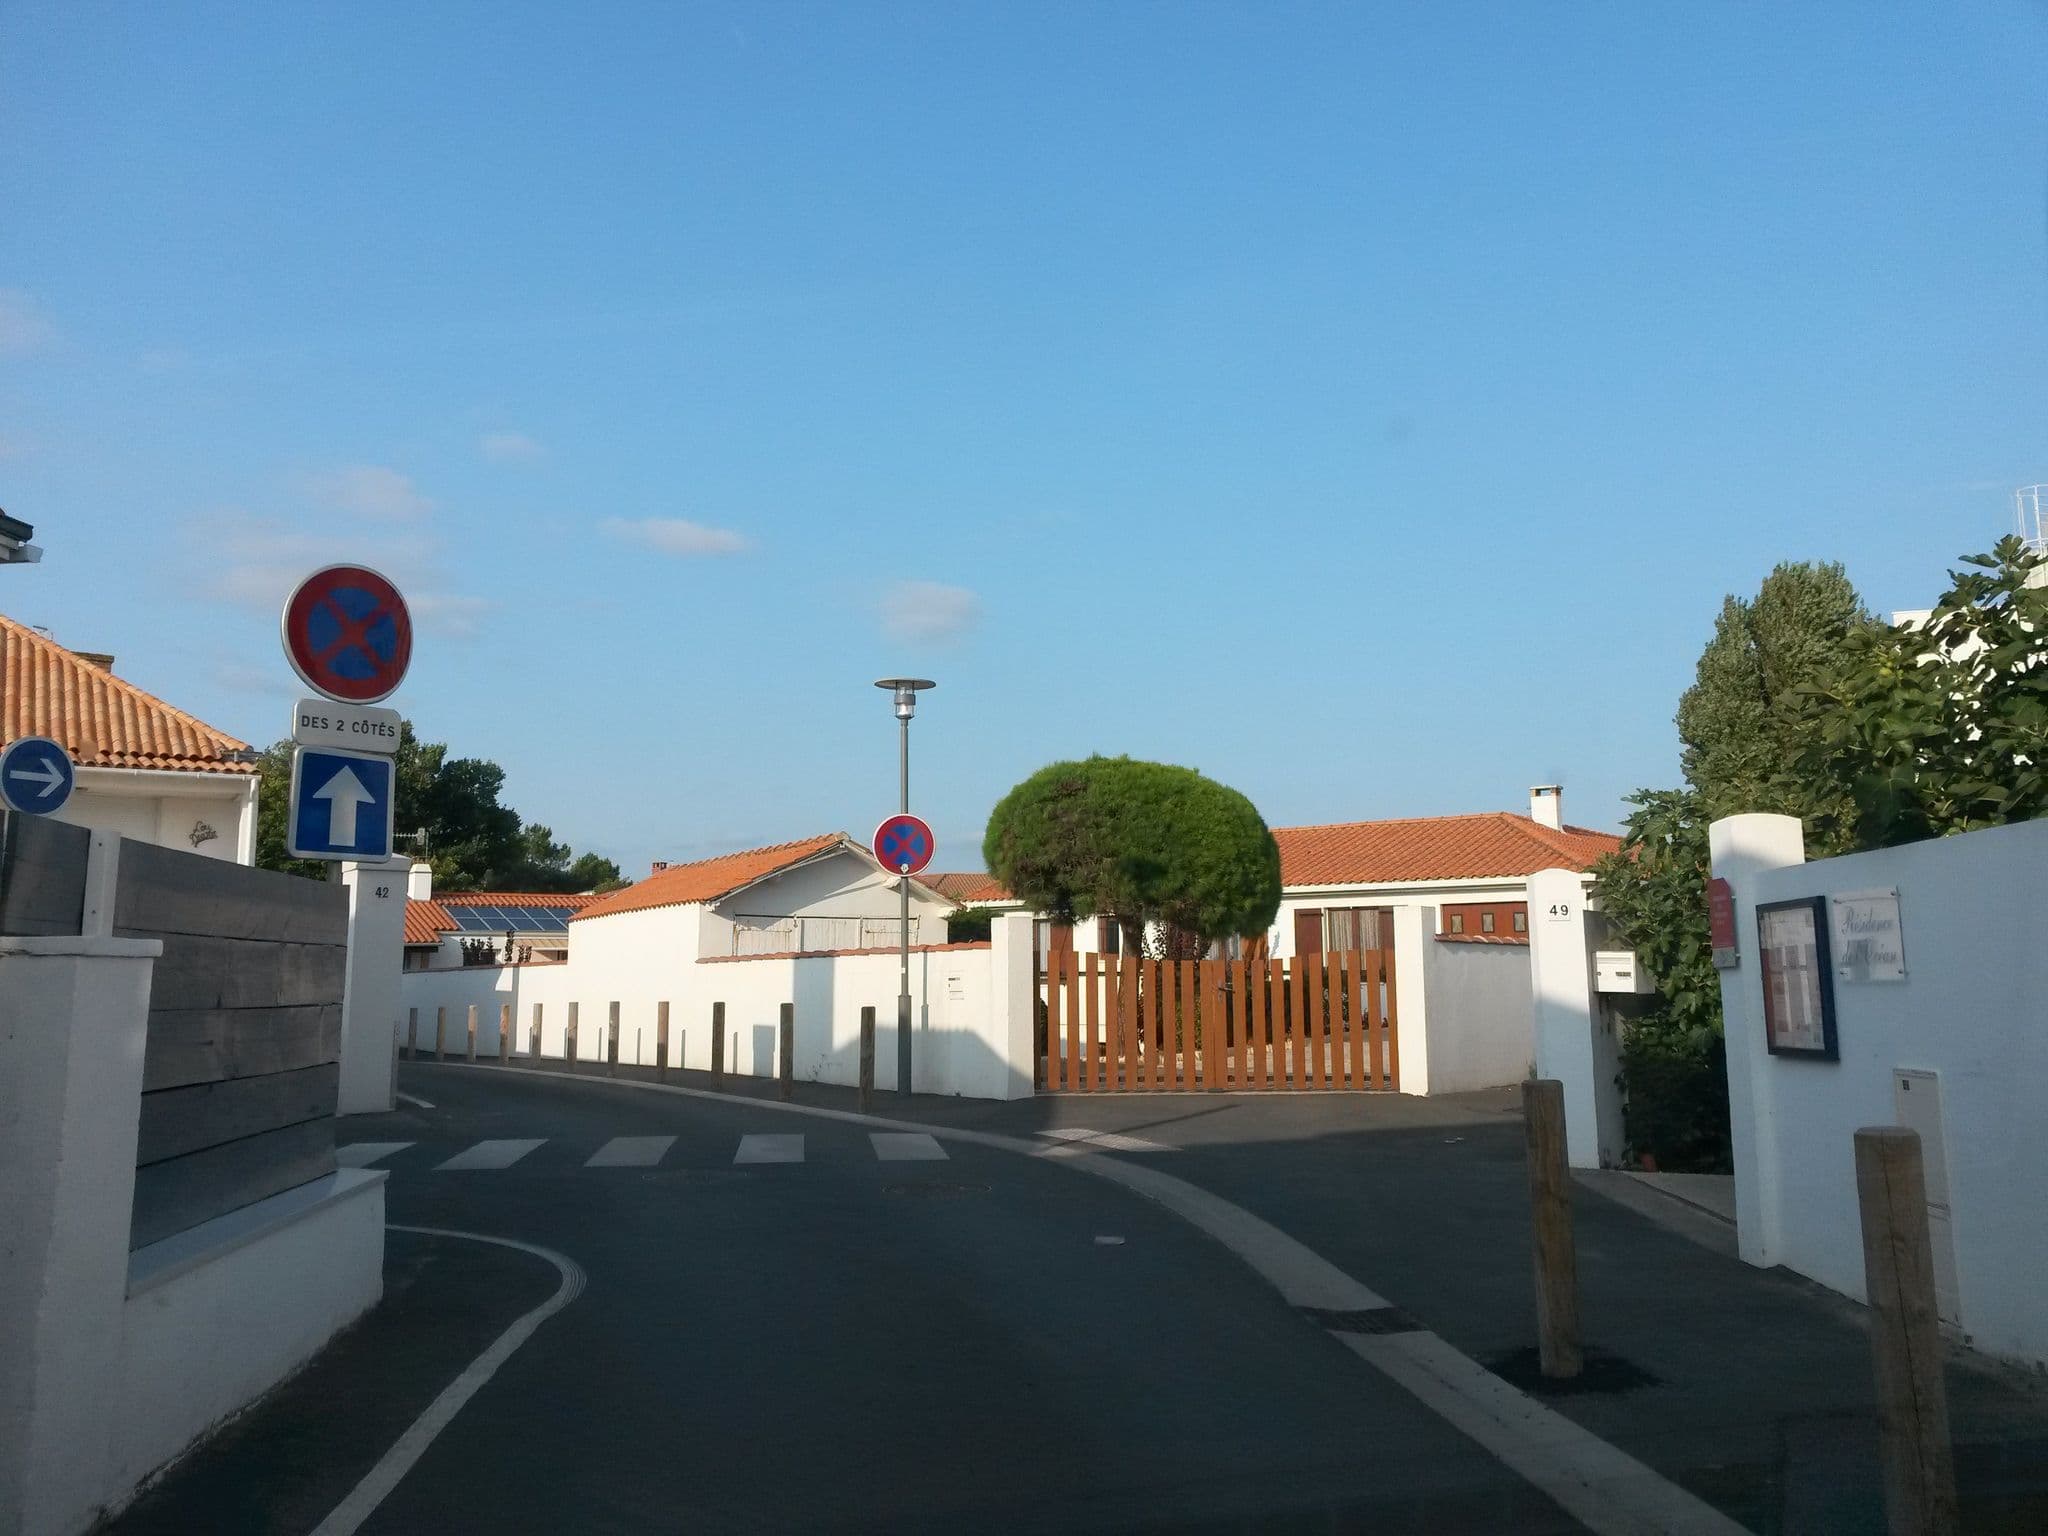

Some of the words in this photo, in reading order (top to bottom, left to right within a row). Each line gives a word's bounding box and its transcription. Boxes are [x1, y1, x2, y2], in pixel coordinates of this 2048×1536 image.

[301, 715, 329, 729] DES
[336, 719, 345, 731] 2
[352, 720, 395, 737] CÔTÉS
[375, 886, 389, 898] 42
[1549, 904, 1569, 916] 49
